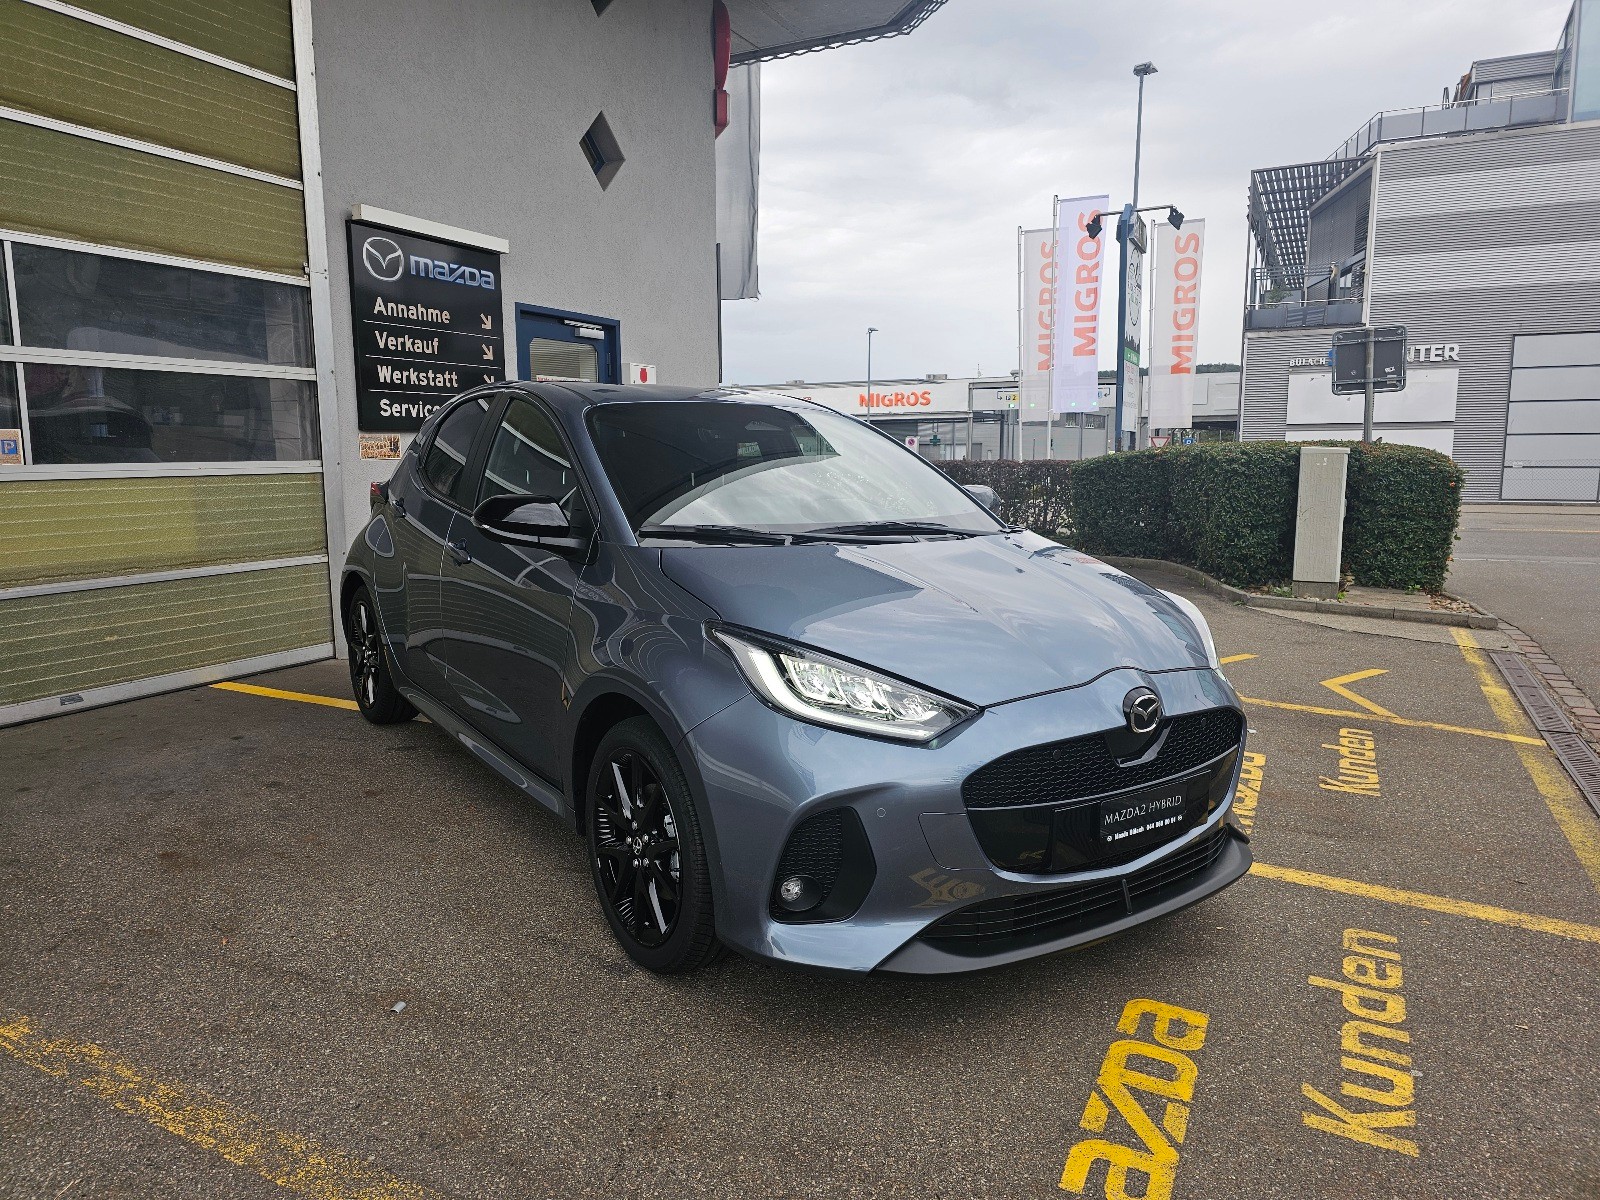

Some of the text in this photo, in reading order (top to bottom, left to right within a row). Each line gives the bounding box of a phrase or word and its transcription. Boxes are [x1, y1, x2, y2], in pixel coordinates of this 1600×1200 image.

[1073, 210, 1103, 356] MIGROS
[373, 297, 451, 324] Annahme
[1038, 239, 1059, 371] MIGROS
[1171, 233, 1200, 375] MIGROS
[374, 330, 439, 355] Verkauf
[377, 364, 459, 388] Werkstatt
[379, 398, 442, 418] Servic
[859, 390, 932, 408] MIGROS
[1319, 727, 1381, 797] Kunden
[1104, 804, 1146, 825] MAZDA2
[1148, 796, 1182, 813] HYBRID
[1301, 928, 1420, 1158] Kunden
